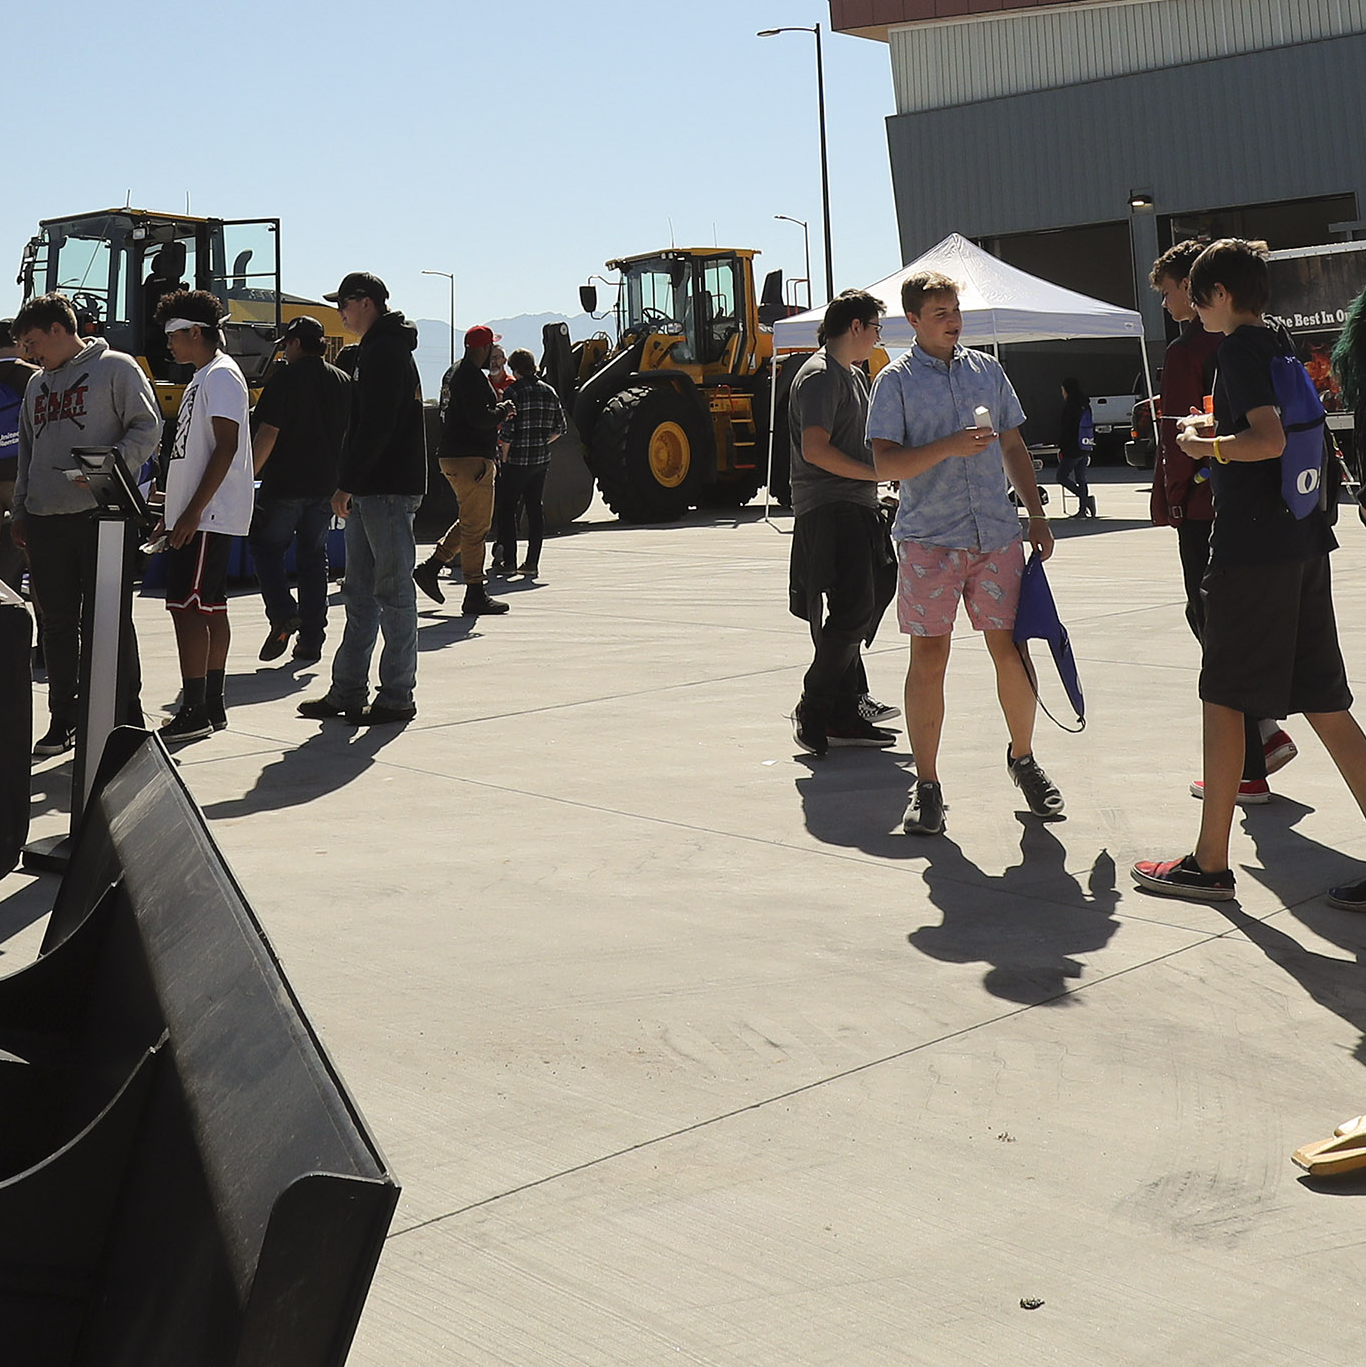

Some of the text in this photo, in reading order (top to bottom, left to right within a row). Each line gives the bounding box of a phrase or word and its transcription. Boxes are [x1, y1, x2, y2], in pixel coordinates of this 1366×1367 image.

[1293, 312, 1320, 327] Best
[1320, 310, 1335, 324] In
[34, 385, 89, 414] EAST
